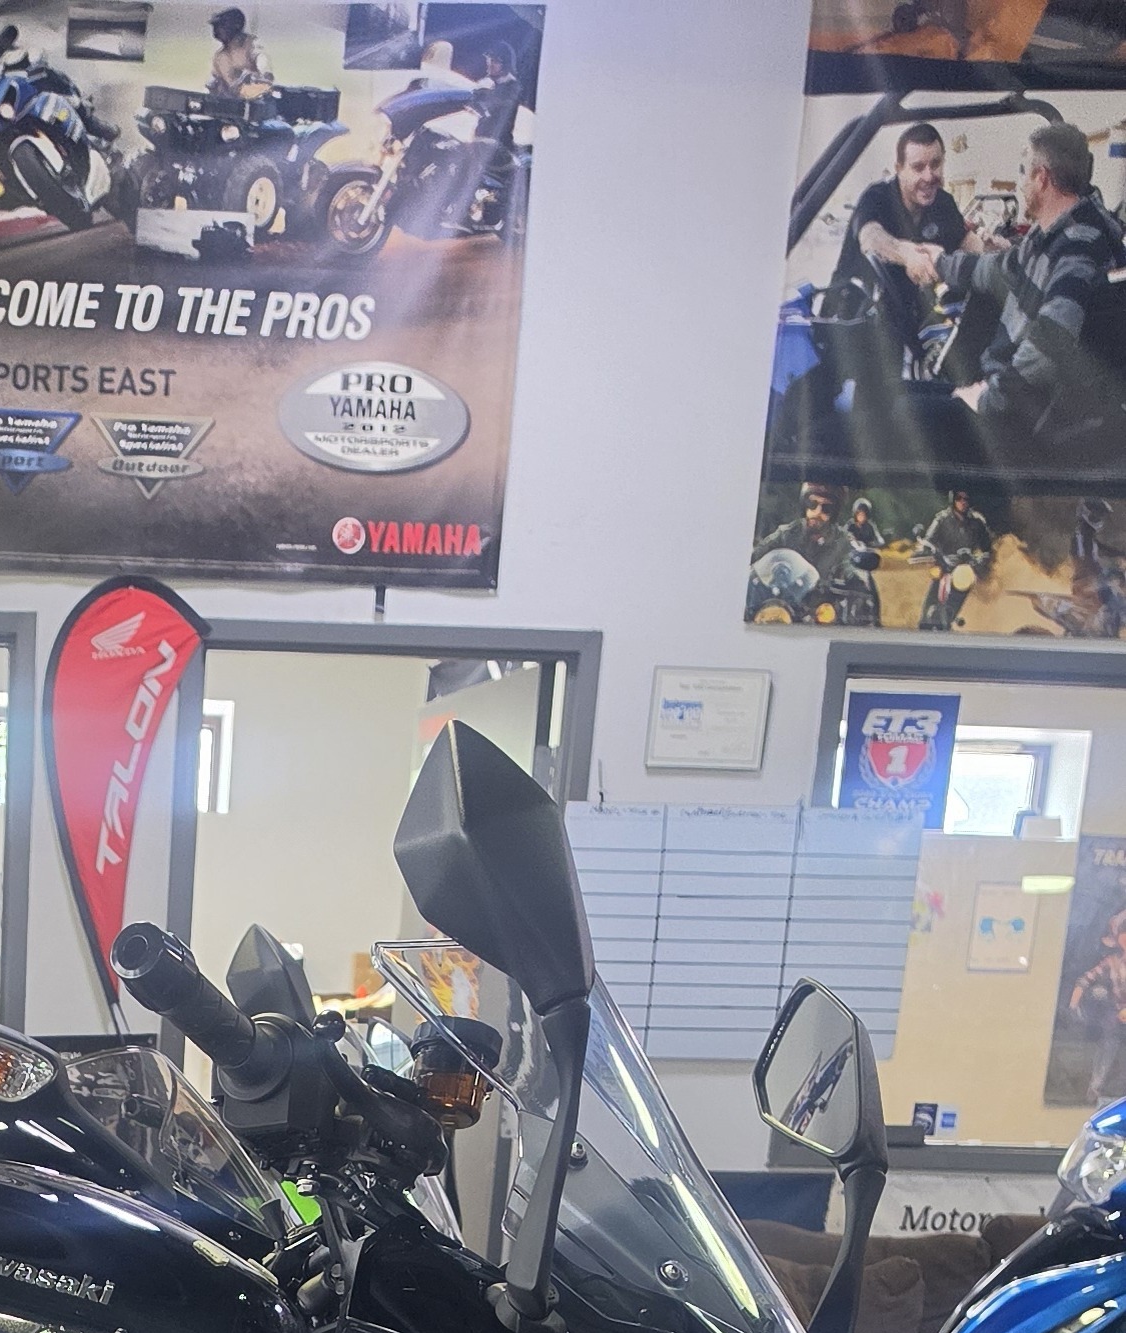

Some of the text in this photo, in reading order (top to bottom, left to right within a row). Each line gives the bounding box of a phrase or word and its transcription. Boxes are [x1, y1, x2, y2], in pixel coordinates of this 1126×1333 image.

[114, 284, 166, 333] TO
[177, 286, 256, 336] THE
[260, 291, 376, 341] PROS
[98, 366, 177, 397] EAST
[341, 373, 413, 394] PRO
[329, 397, 416, 421] YAMAHA
[343, 422, 406, 433] 2012
[111, 458, 190, 475] Outdoor
[367, 521, 482, 556] YAMAHA
[95, 639, 177, 875] TALON
[885, 745, 909, 774] 1
